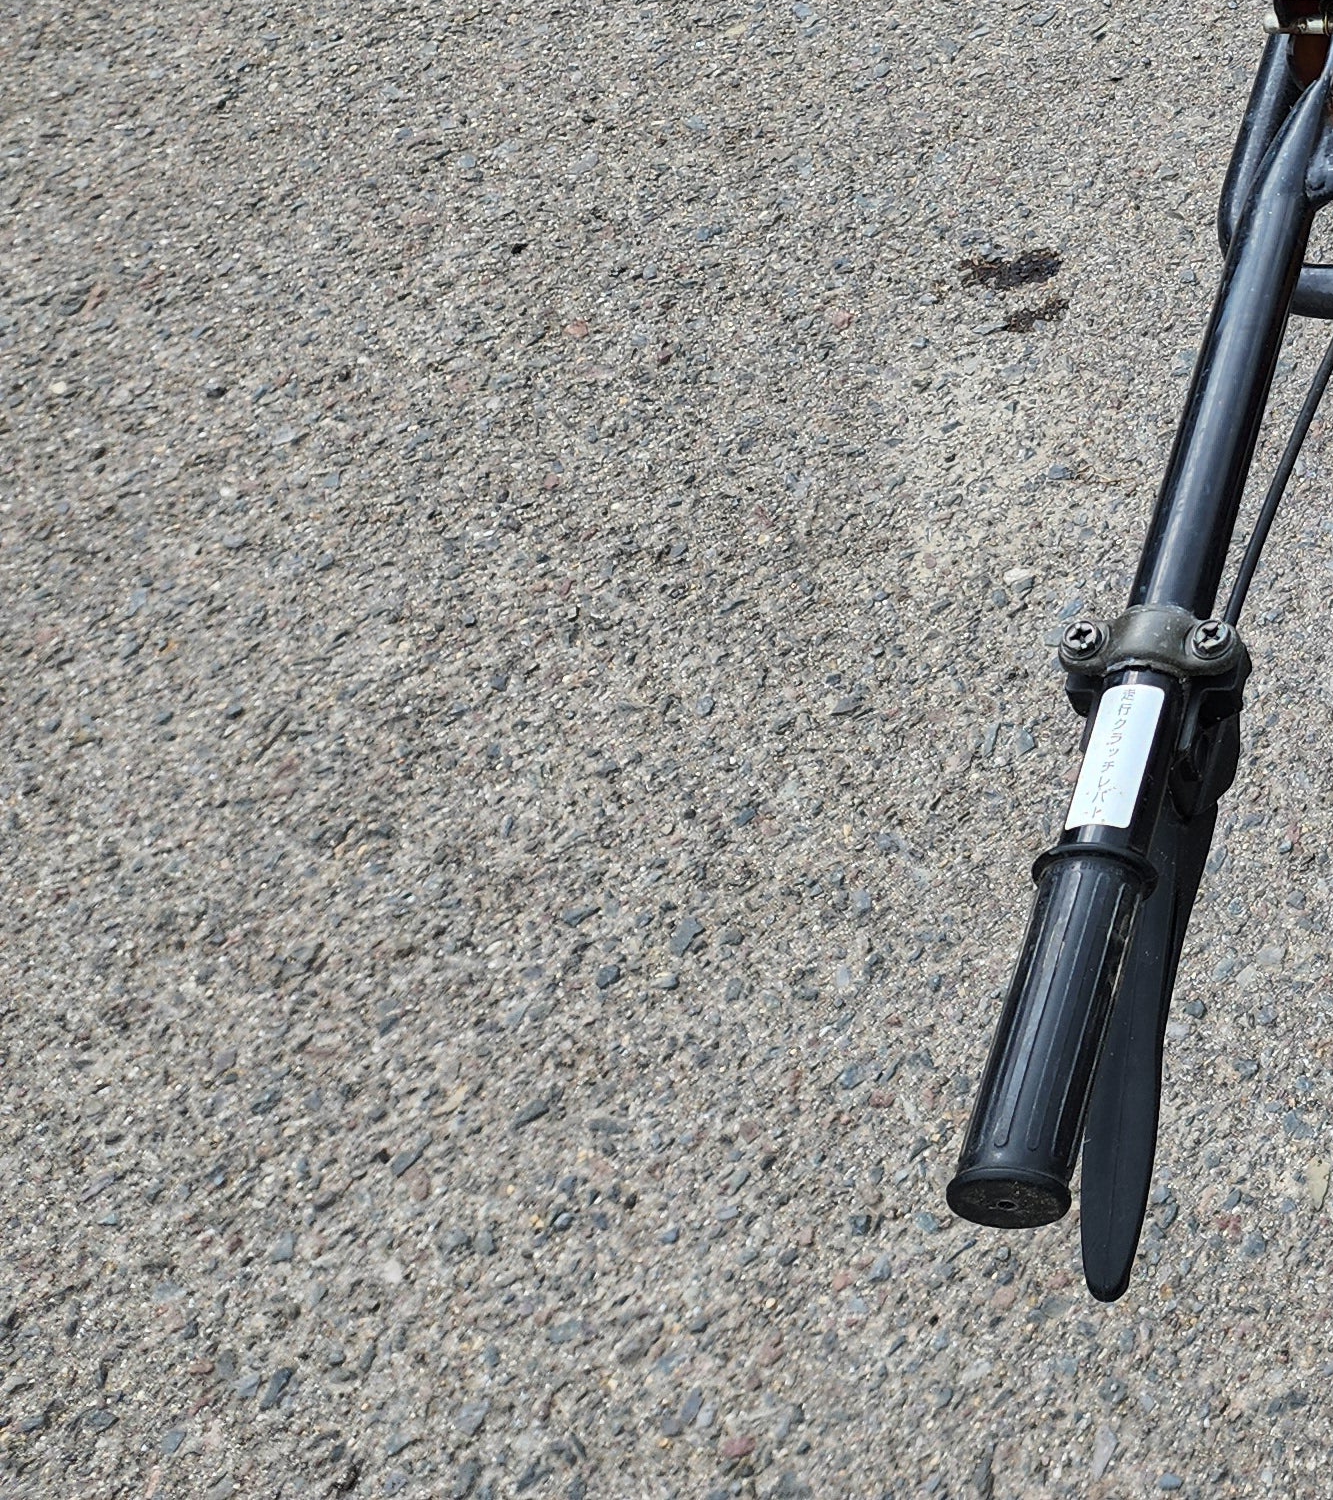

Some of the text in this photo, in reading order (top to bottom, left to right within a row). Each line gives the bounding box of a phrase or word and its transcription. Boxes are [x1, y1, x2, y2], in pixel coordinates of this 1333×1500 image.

[1091, 689, 1136, 821] 走行クラッチレバー
